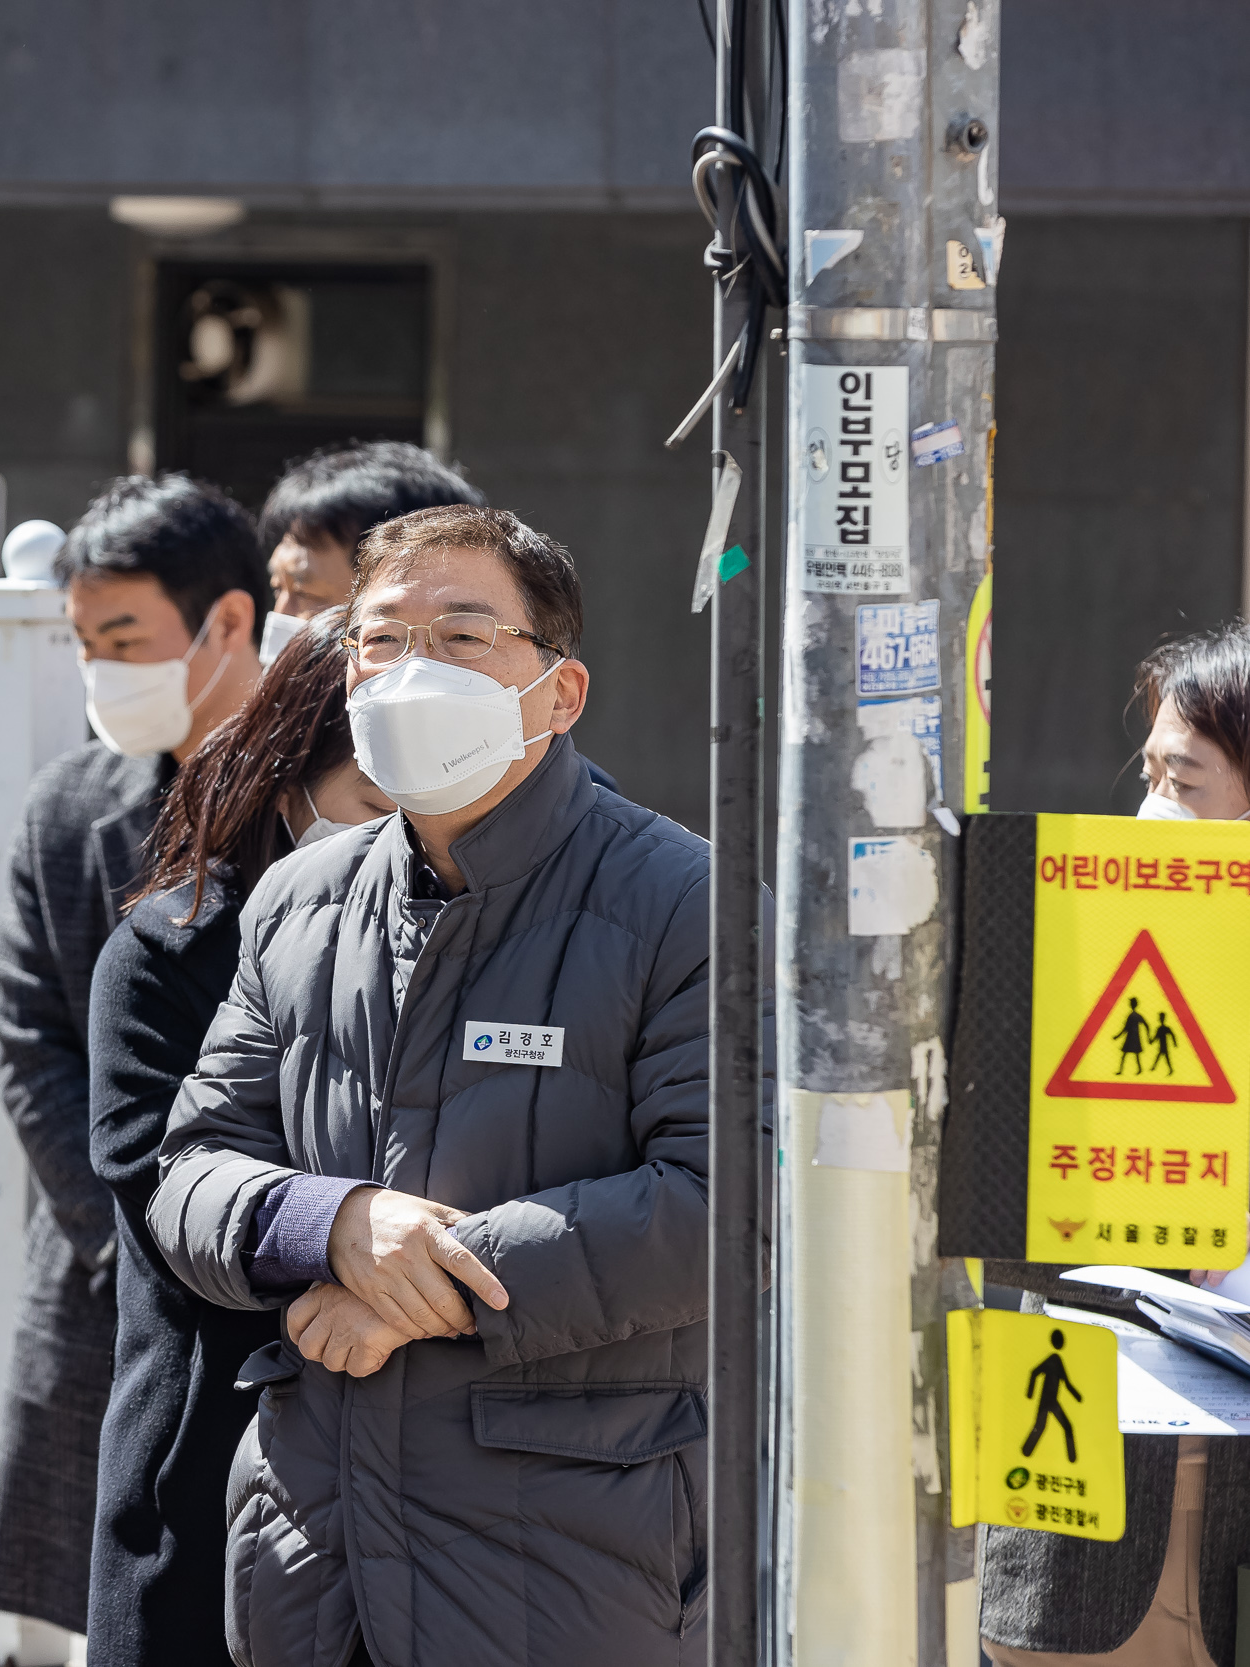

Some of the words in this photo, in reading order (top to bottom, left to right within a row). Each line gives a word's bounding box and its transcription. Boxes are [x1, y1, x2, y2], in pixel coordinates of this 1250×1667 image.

[837, 372, 872, 544] 인부모집
[448, 743, 485, 769] Welkeeps
[504, 1049, 545, 1060] 광진구청장
[1050, 1145, 1227, 1187] 주정차금지
